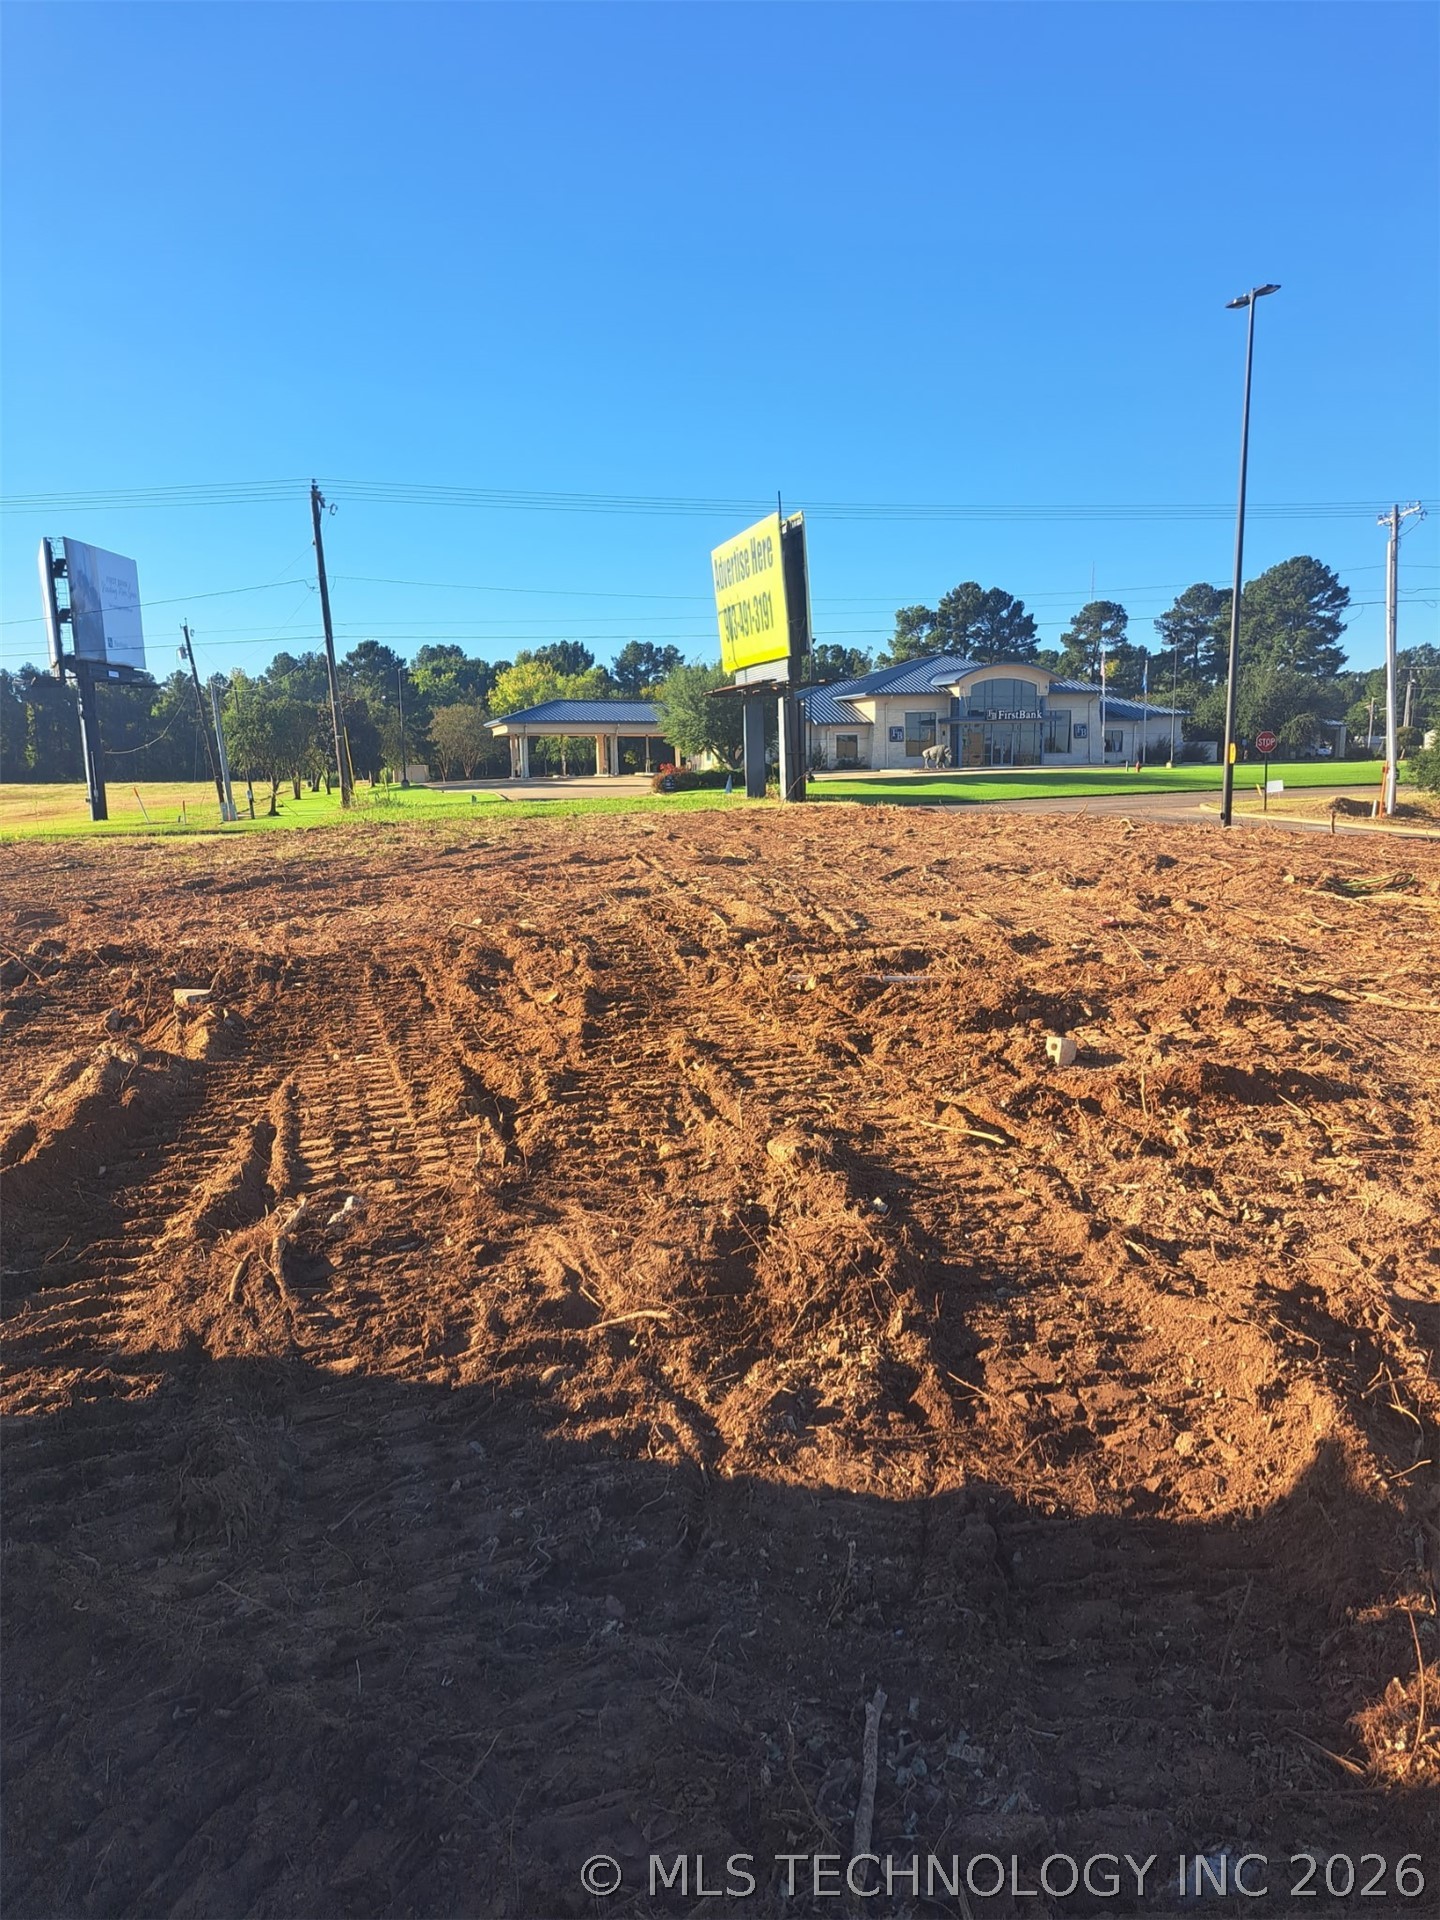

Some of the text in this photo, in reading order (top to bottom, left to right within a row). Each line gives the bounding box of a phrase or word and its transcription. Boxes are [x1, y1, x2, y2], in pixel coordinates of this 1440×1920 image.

[715, 536, 773, 591] Advertise Here
[725, 591, 774, 643] 903-491-3191
[998, 710, 1042, 720] FirstBank
[1258, 737, 1276, 747] STOP
